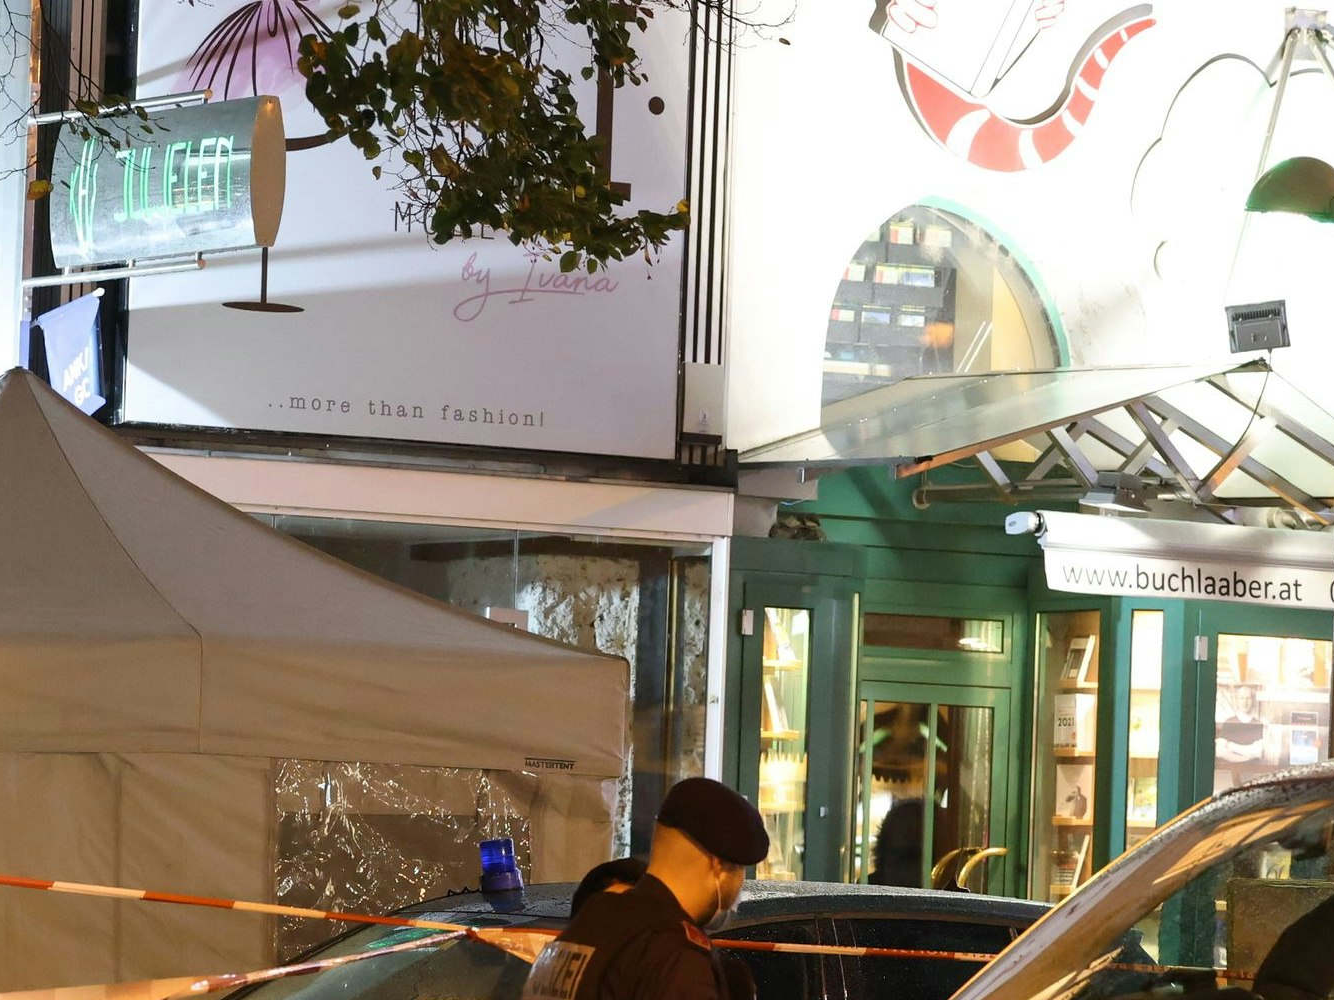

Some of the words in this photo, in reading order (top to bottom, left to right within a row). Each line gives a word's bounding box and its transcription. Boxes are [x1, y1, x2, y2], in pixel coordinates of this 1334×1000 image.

[454, 252, 492, 322] by
[509, 252, 619, 304] Ivana
[368, 400, 424, 419] than
[441, 405, 545, 427] fashion!
[1062, 564, 1303, 602] www.buchlaaber.at
